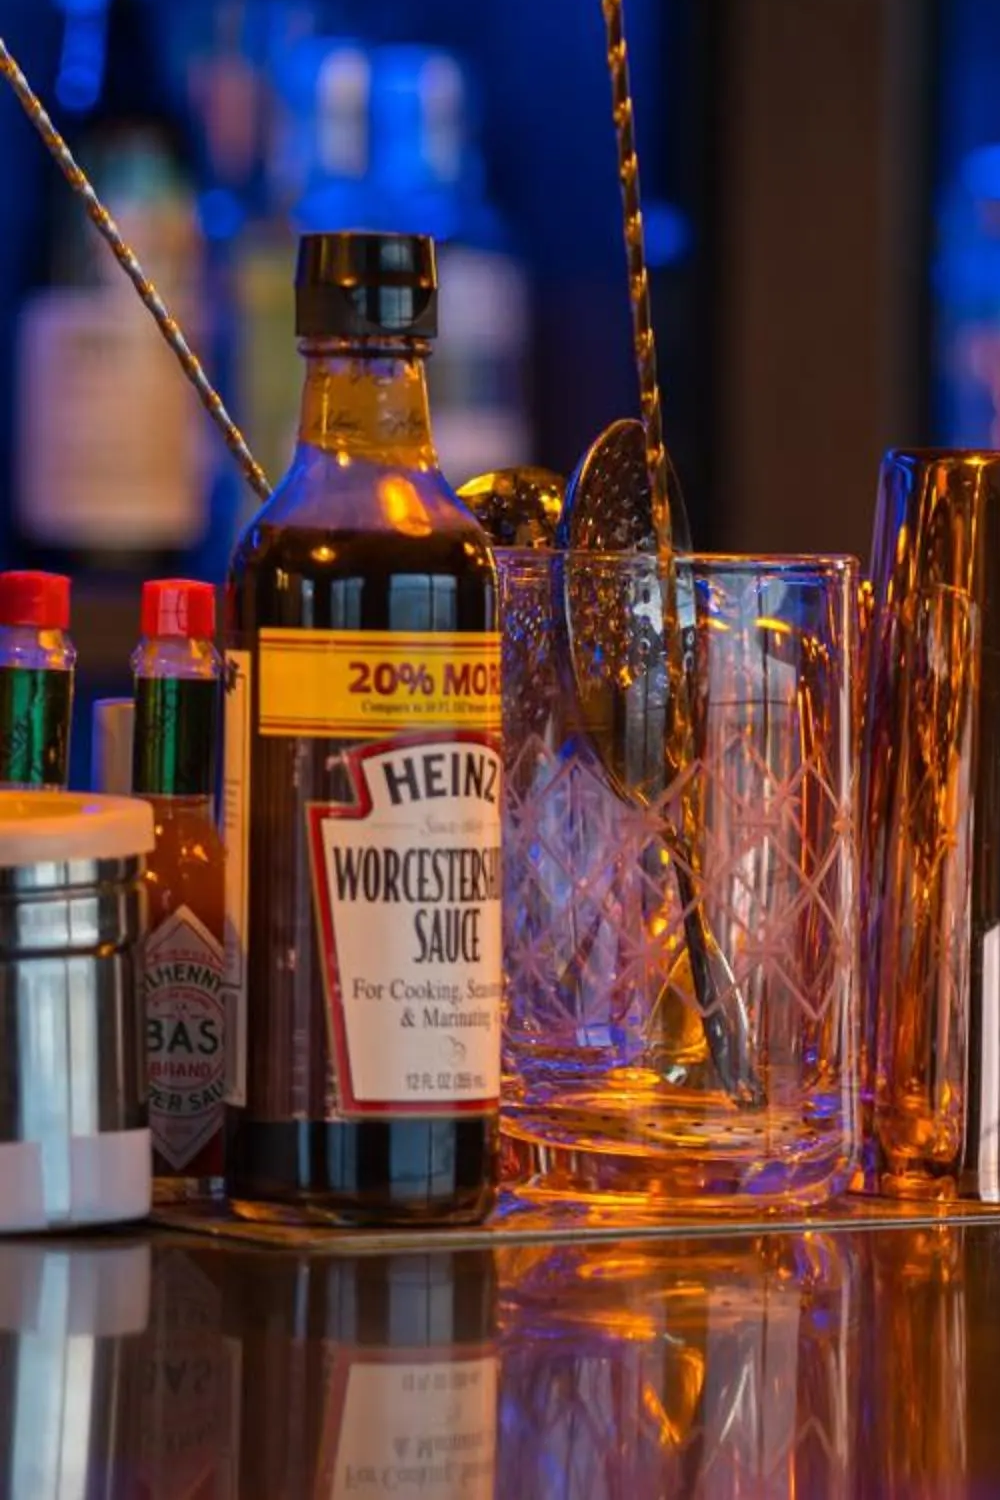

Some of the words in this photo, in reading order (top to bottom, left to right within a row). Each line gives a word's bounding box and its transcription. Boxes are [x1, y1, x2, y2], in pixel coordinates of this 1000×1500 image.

[347, 661, 435, 696] 20%
[442, 662, 502, 697] MOR
[382, 752, 498, 805] HEINZ
[413, 908, 481, 963] SAUCE
[353, 978, 384, 1000] For
[390, 979, 463, 1005] Cooking,
[401, 1009, 415, 1027] &
